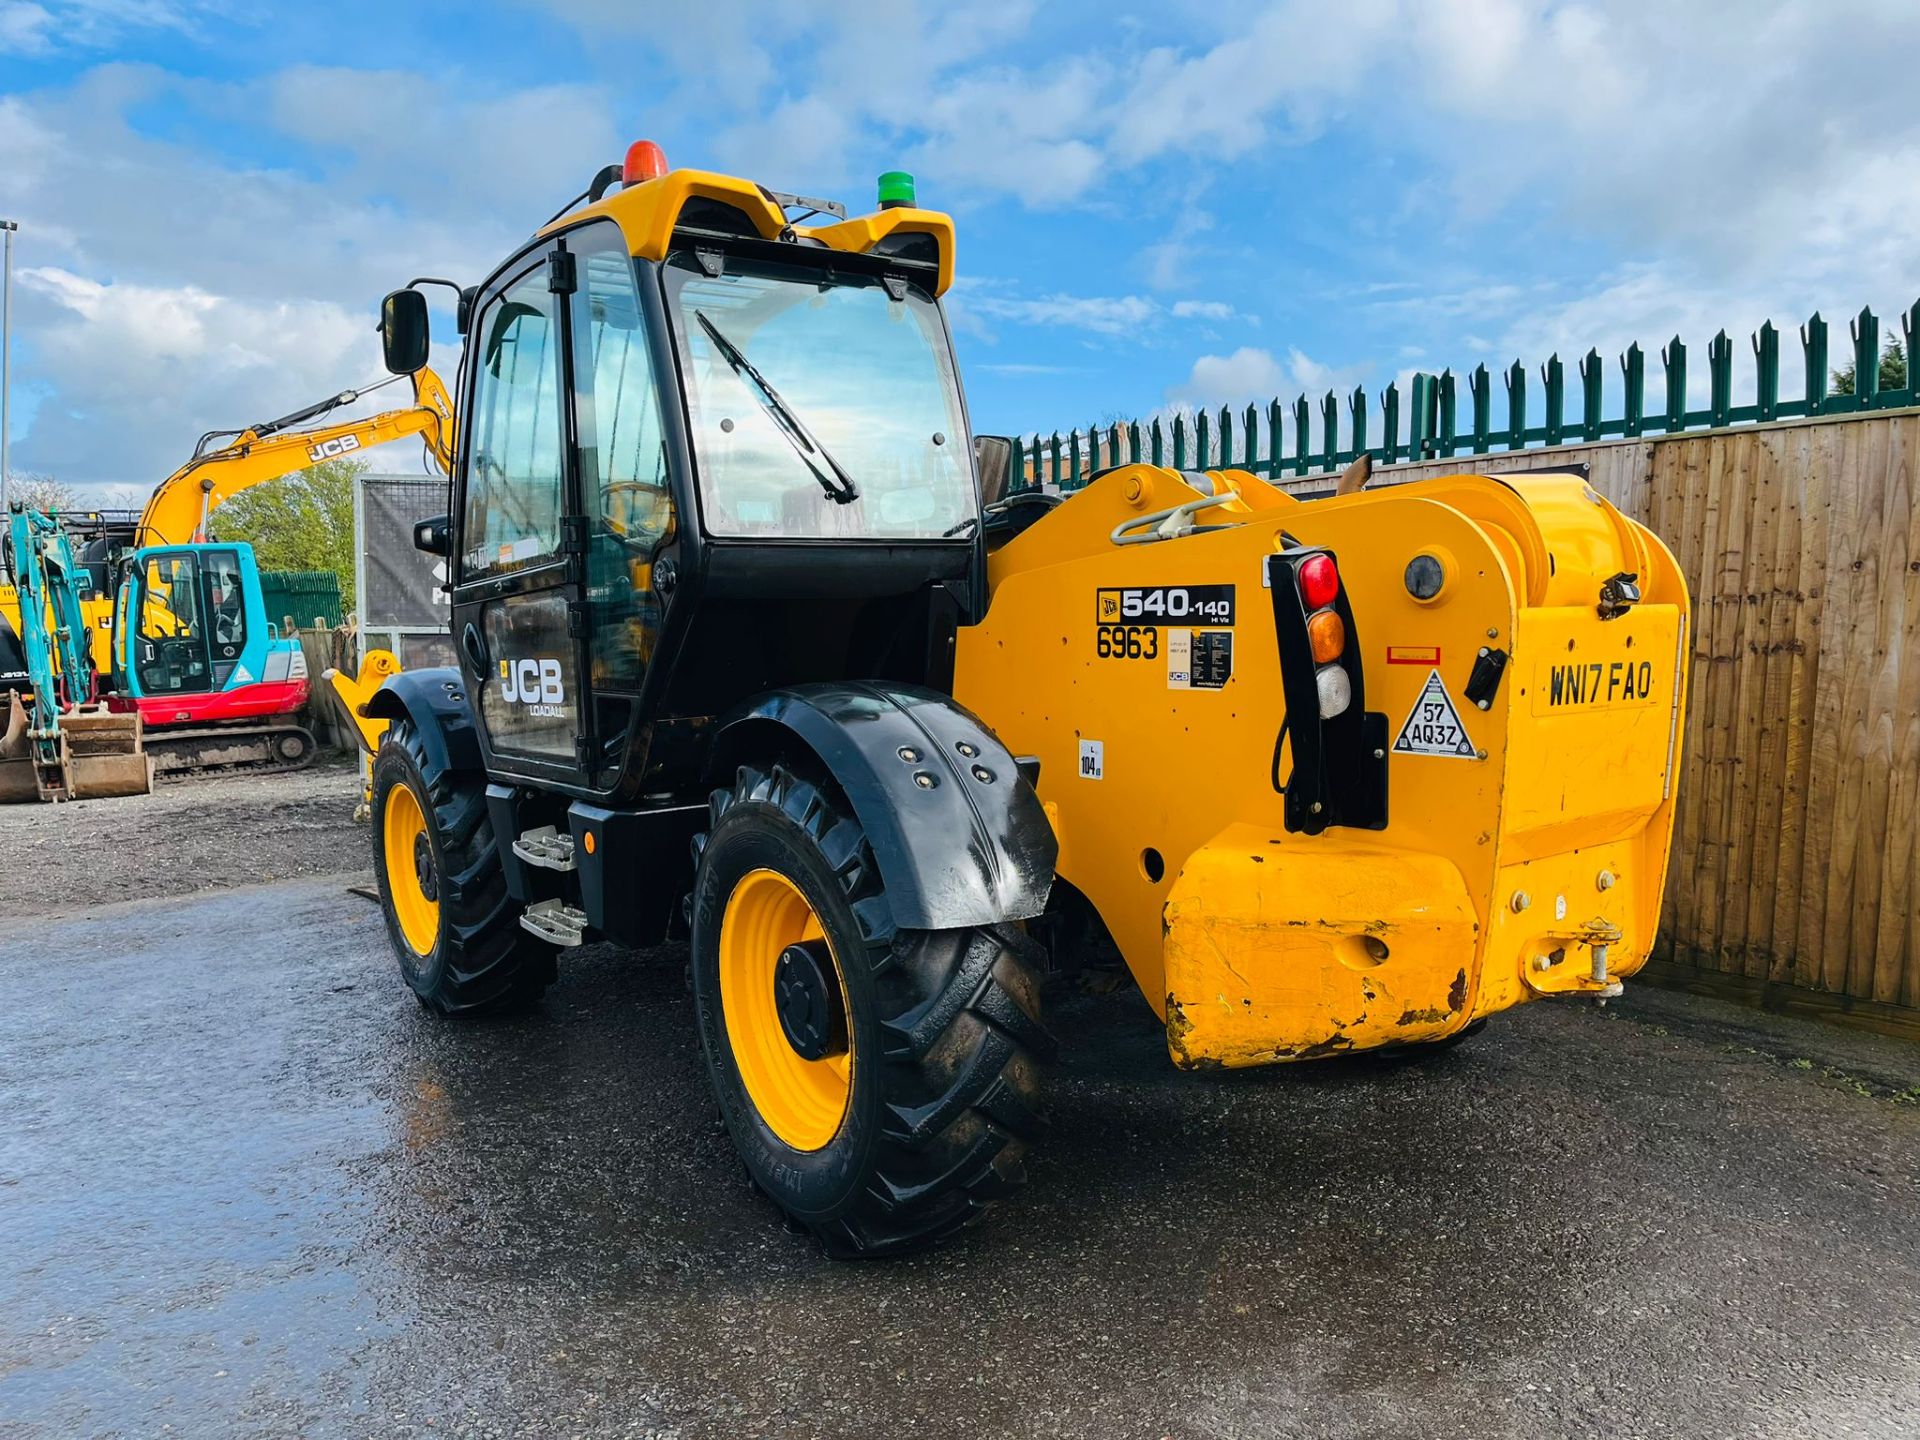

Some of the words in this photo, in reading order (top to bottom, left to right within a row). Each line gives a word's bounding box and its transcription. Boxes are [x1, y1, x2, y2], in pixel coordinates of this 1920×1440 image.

[307, 434, 361, 462] JCB
[1102, 598, 1118, 616] JCB
[1097, 626, 1158, 659] 6963
[500, 659, 564, 704] JCB
[1169, 672, 1189, 681] JCB
[1550, 663, 1603, 707] WN17
[529, 705, 564, 717] LOADALL
[1424, 703, 1445, 723] 57
[1412, 724, 1457, 746] AQ3Z
[1081, 755, 1095, 775] 104
